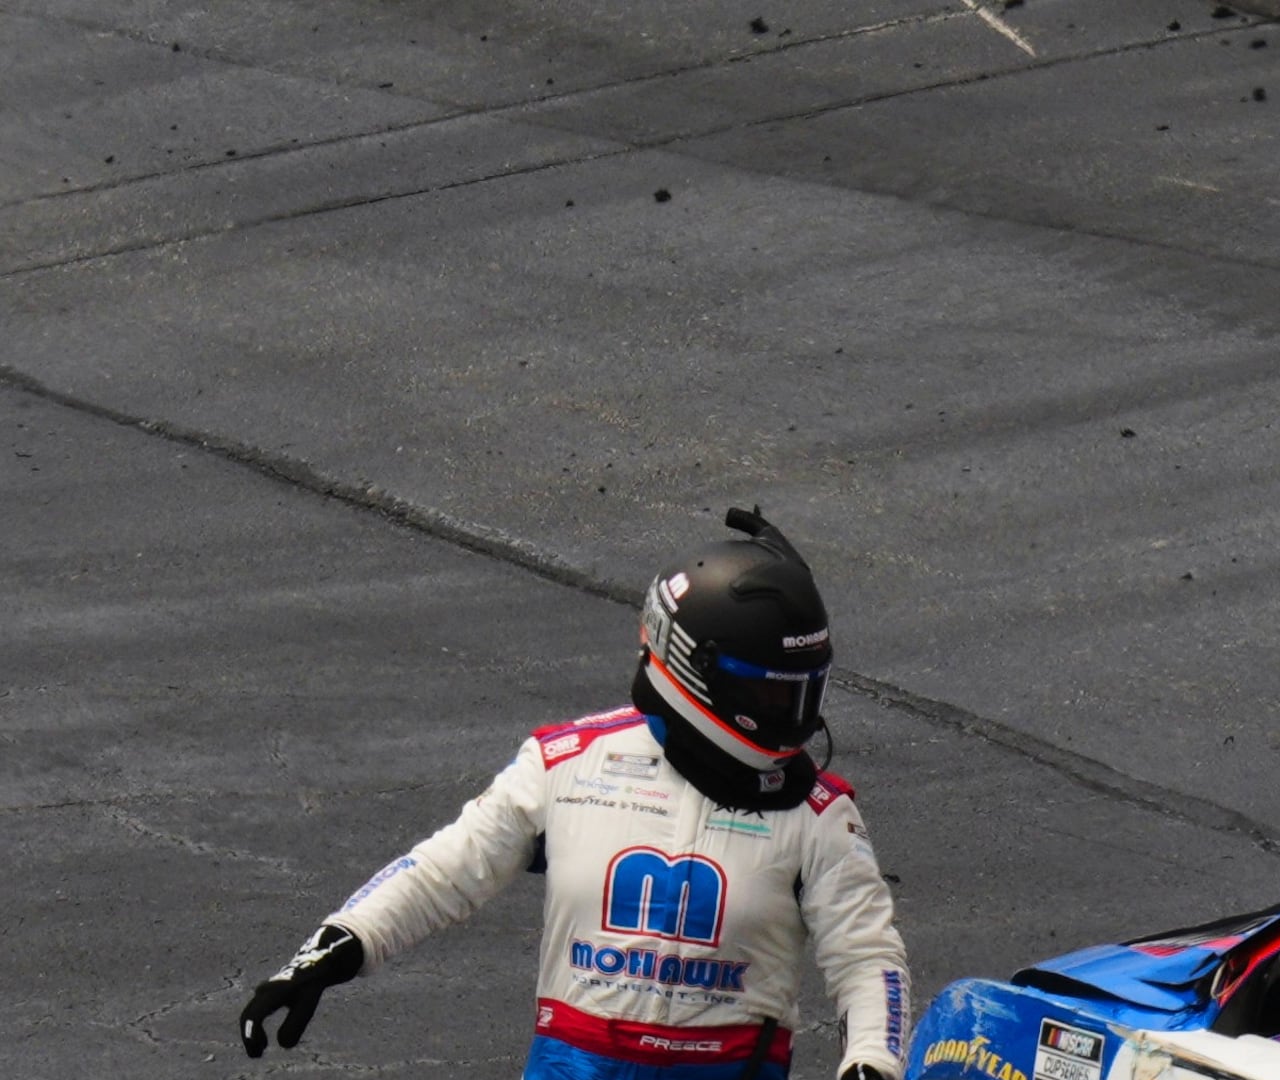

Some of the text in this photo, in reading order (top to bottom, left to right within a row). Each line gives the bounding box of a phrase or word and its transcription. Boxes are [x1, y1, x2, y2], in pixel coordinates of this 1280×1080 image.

[634, 787, 670, 800] Castrol
[556, 795, 616, 808] GOODYEAR
[631, 802, 669, 817] Trimble
[570, 939, 750, 992] MOHAWK
[639, 1034, 723, 1052] PREECE
